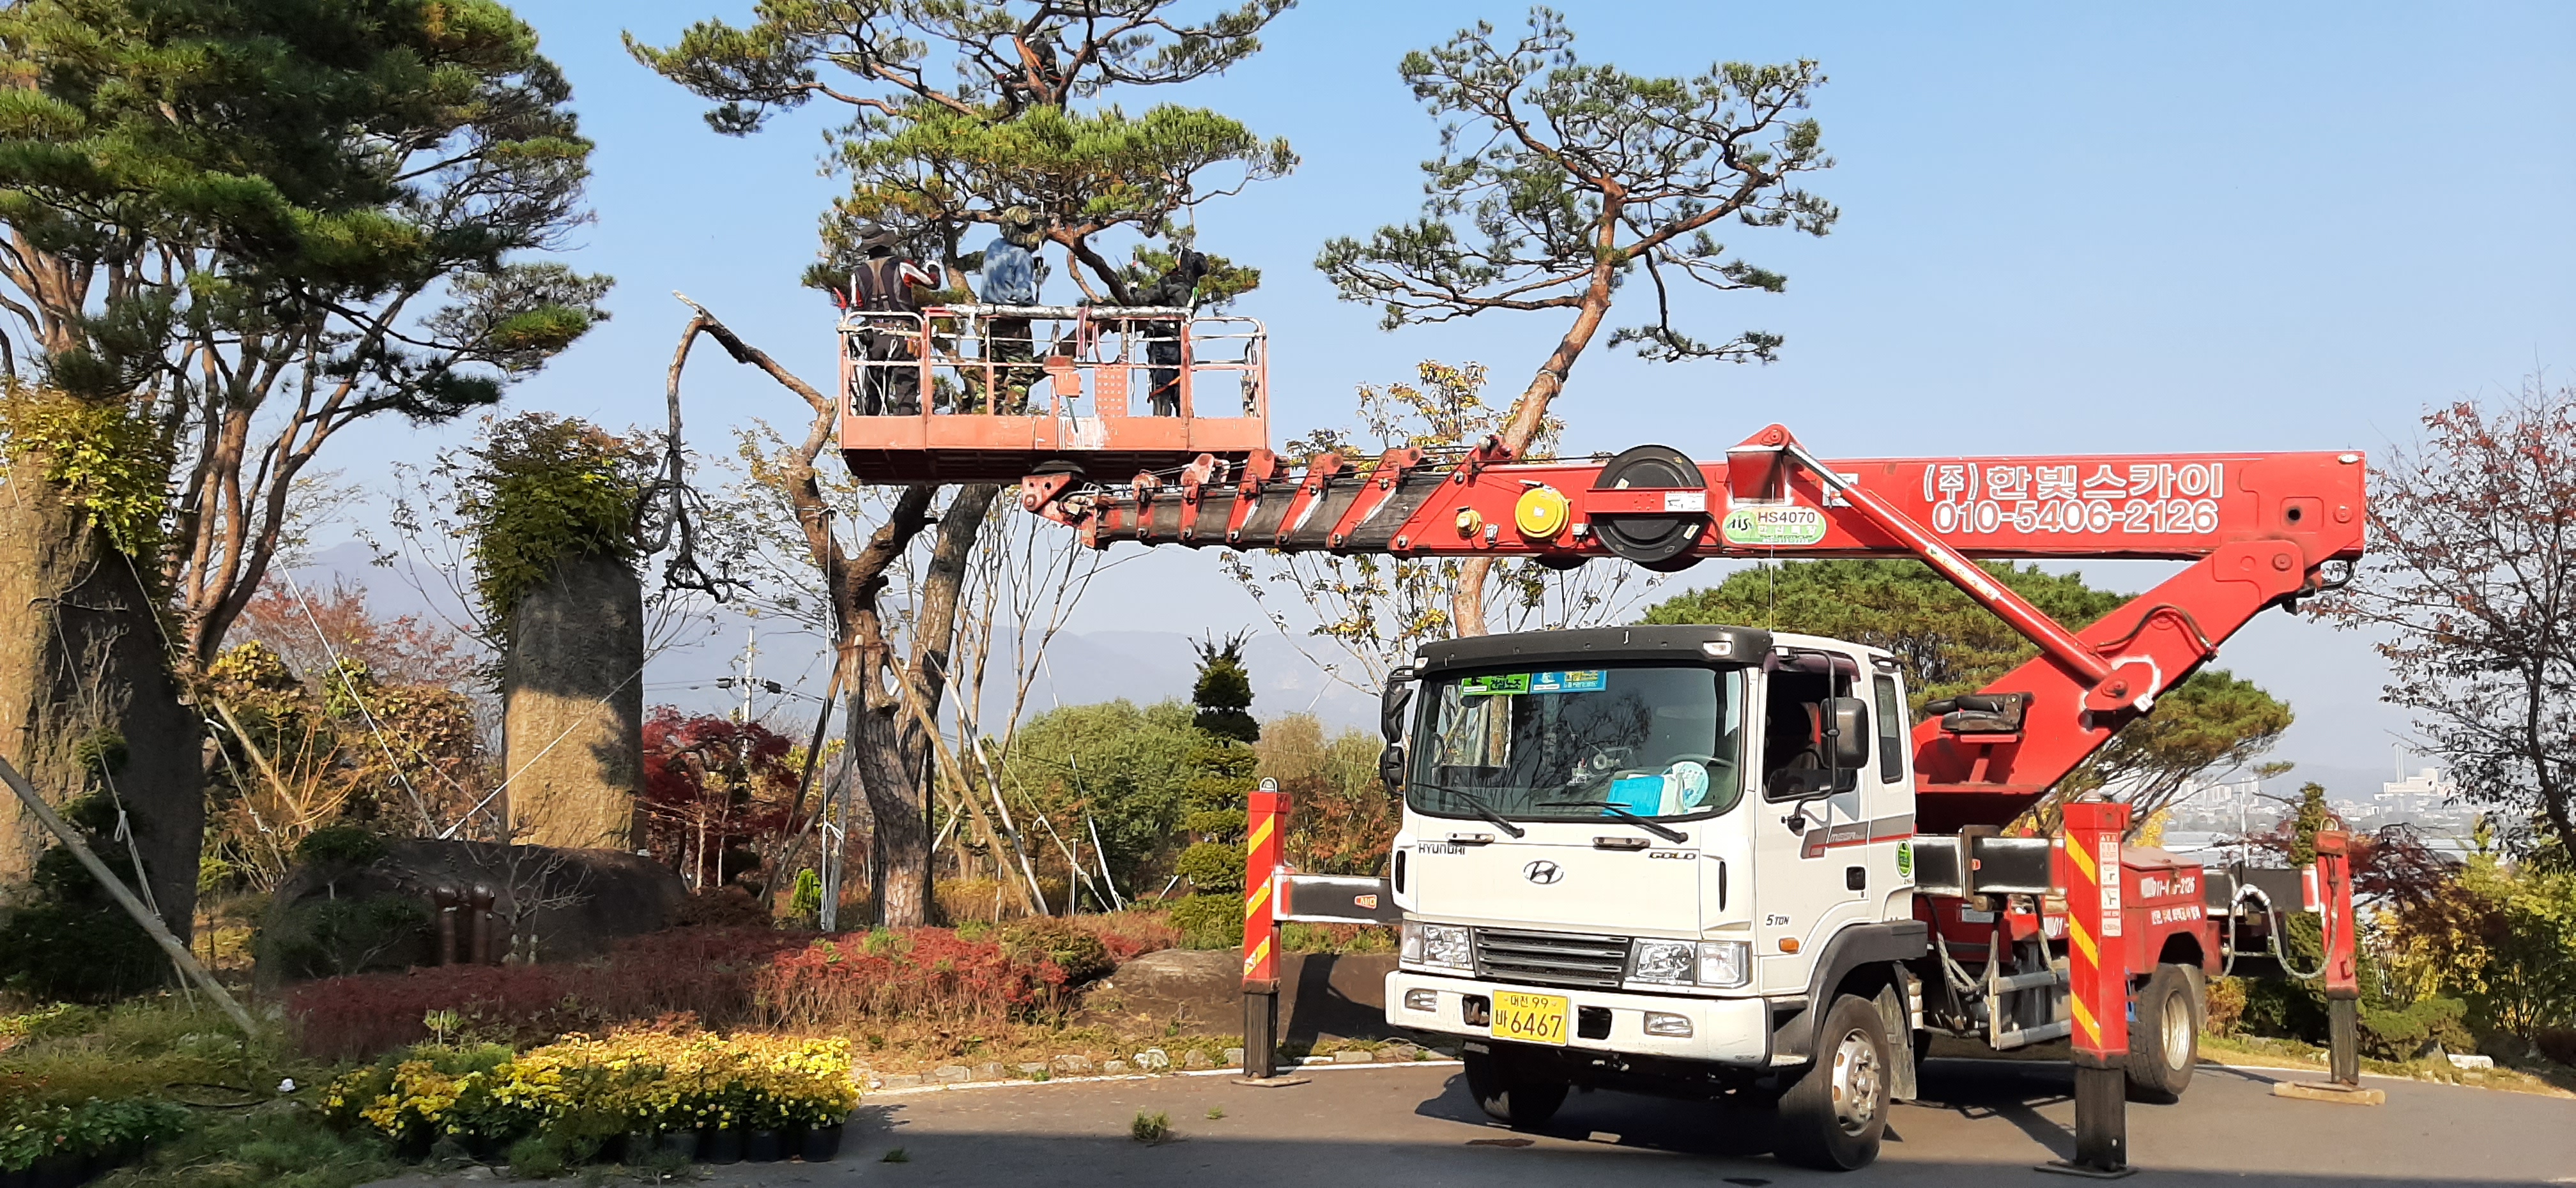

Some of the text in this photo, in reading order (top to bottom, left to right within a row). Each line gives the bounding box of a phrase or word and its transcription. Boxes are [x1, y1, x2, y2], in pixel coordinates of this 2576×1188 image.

[1758, 511, 1816, 523] HS4070
[1932, 499, 2219, 533] 010-5406-2126
[1418, 842, 1465, 855] HYUNDAI
[1648, 851, 1697, 860] GOLD
[1510, 995, 1548, 1009] 대전 99
